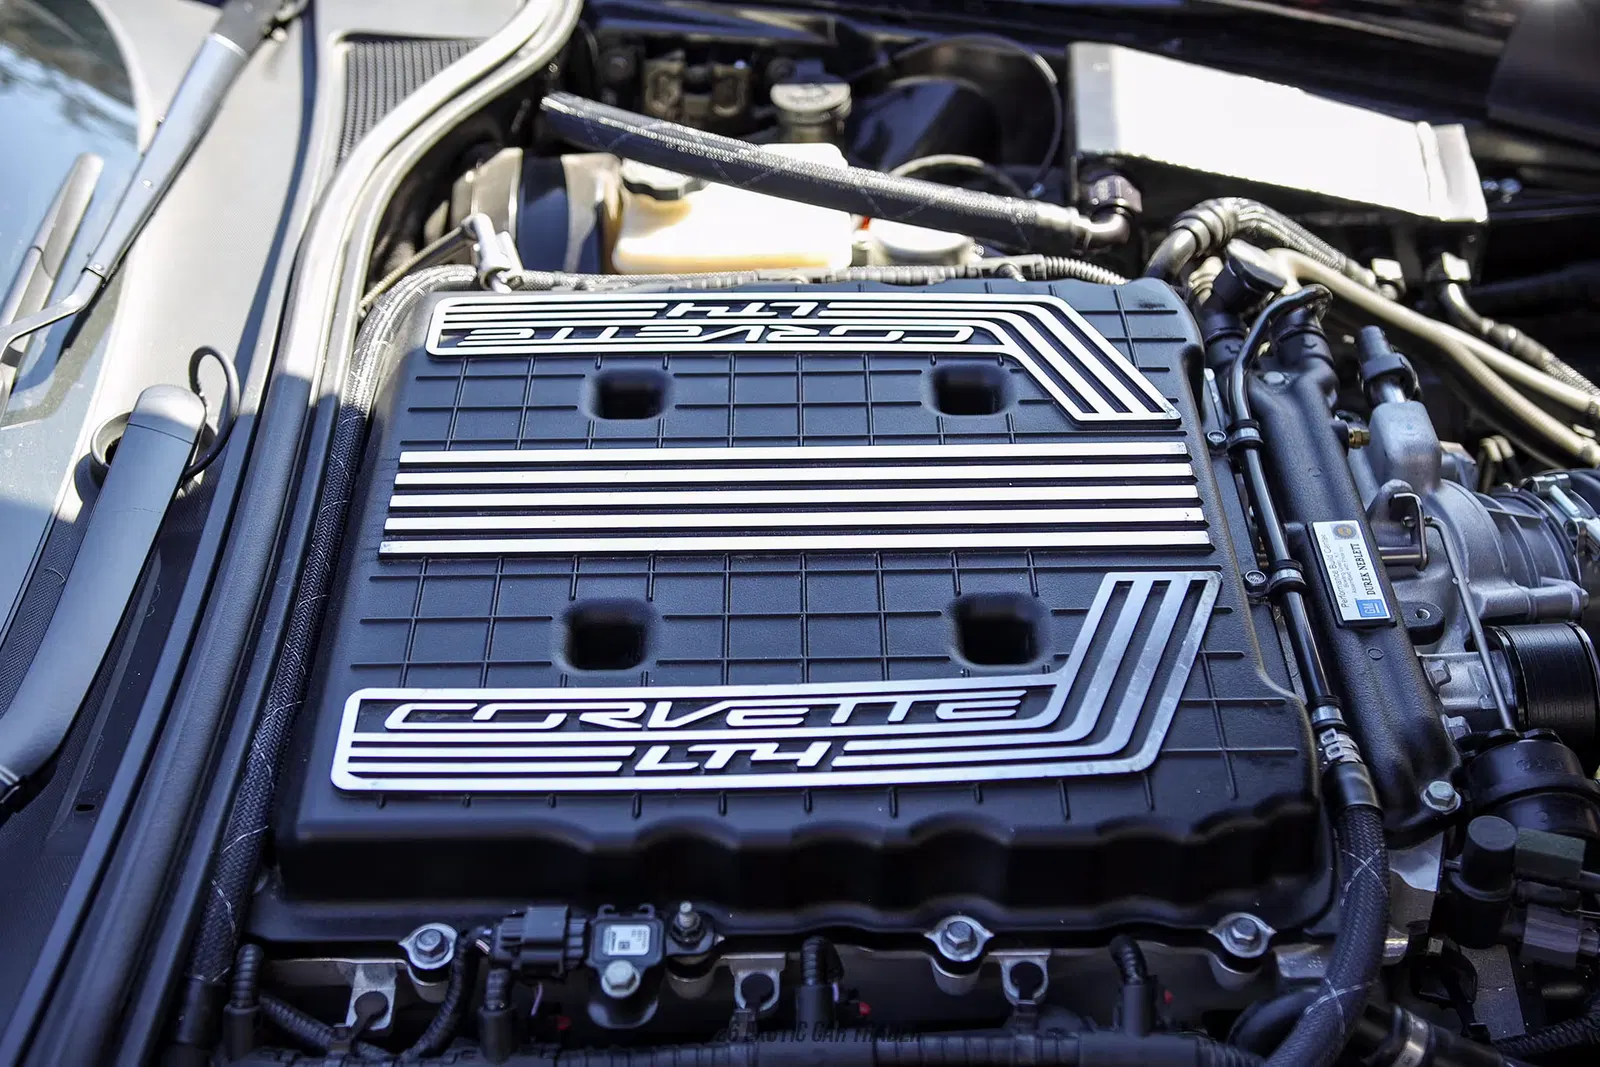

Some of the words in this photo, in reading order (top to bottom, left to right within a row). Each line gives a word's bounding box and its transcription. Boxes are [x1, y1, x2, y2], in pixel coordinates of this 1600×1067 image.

[666, 302, 820, 318] LT4
[456, 325, 975, 347] CORVETTE
[1321, 534, 1331, 553] Center
[1325, 555, 1337, 569] Build
[1350, 543, 1367, 571] NEBLETT
[1333, 571, 1349, 608] Performance
[1360, 572, 1376, 595] DUREK
[1362, 603, 1376, 614] GM
[384, 690, 1027, 729] CORVETTE
[634, 741, 831, 770] LT4
